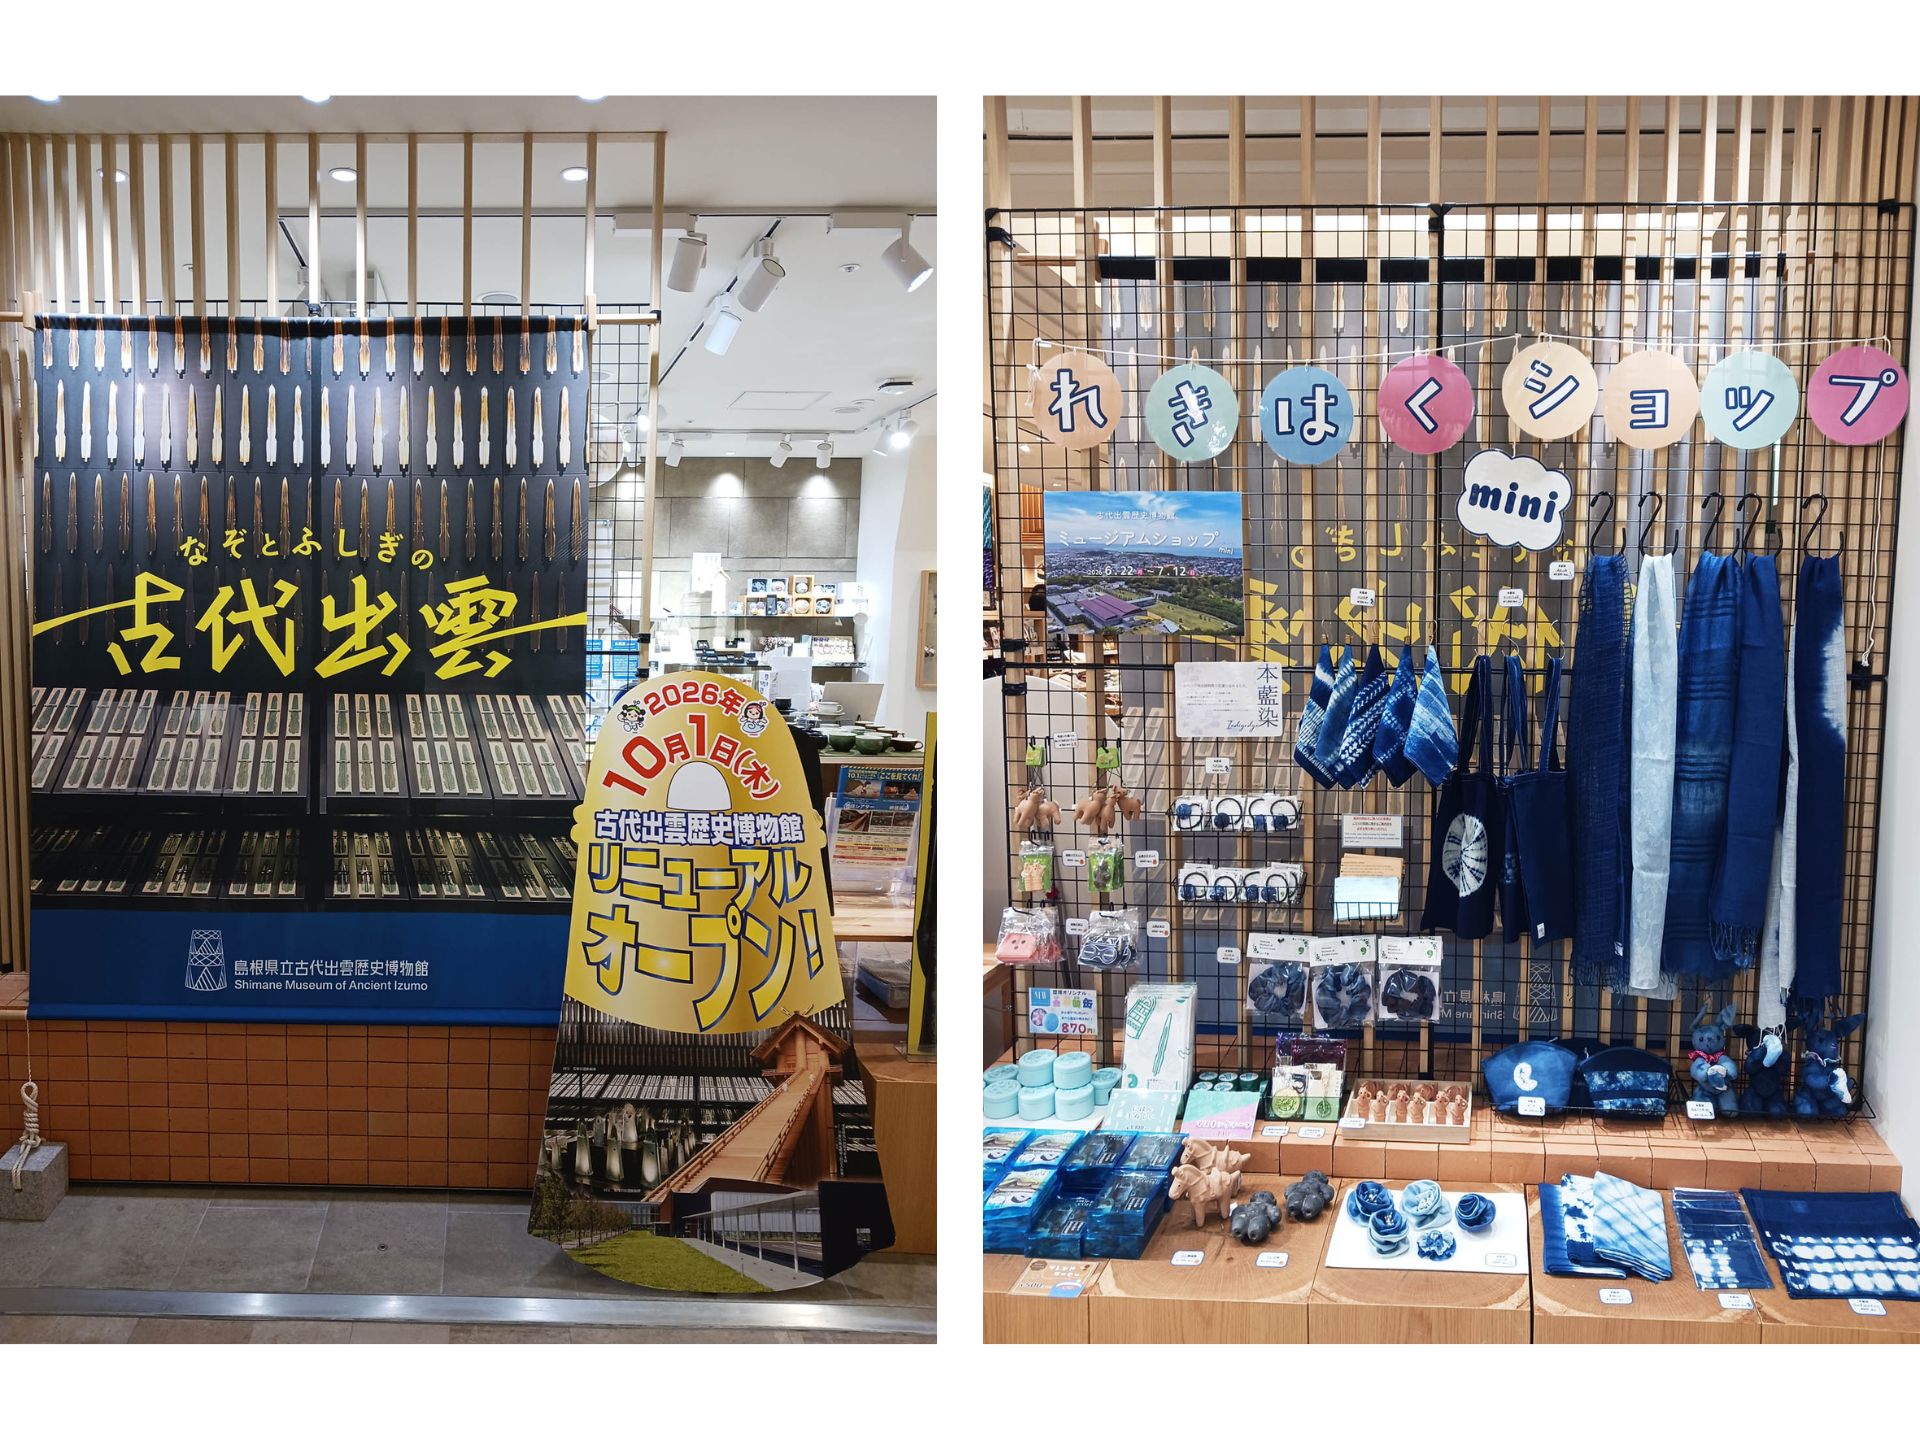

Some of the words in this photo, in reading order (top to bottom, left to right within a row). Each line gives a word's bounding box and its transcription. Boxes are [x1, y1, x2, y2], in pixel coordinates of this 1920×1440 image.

[1096, 511, 1176, 520] 古代出雲歴史博物館
[1469, 481, 1559, 523] mini
[180, 527, 434, 570] なぞとふしぎの
[1058, 530, 1220, 548] ミュージアムショップ
[1218, 546, 1234, 556] mini
[34, 571, 587, 681] 古代出雲
[643, 681, 742, 716] 2026年
[1257, 663, 1279, 728] 本藍染
[602, 713, 782, 801] 10月1日(木)
[595, 809, 805, 847] 古代出雲歴史博物館
[588, 842, 813, 912] リニューアル
[234, 960, 429, 977] 島根県立古代出雲歴史博物館
[234, 979, 283, 990] Shimane
[285, 980, 333, 990] Museum
[335, 980, 346, 990] of
[348, 980, 392, 990] Ancient
[394, 980, 428, 991] Izumo
[582, 904, 824, 1033] オープン！
